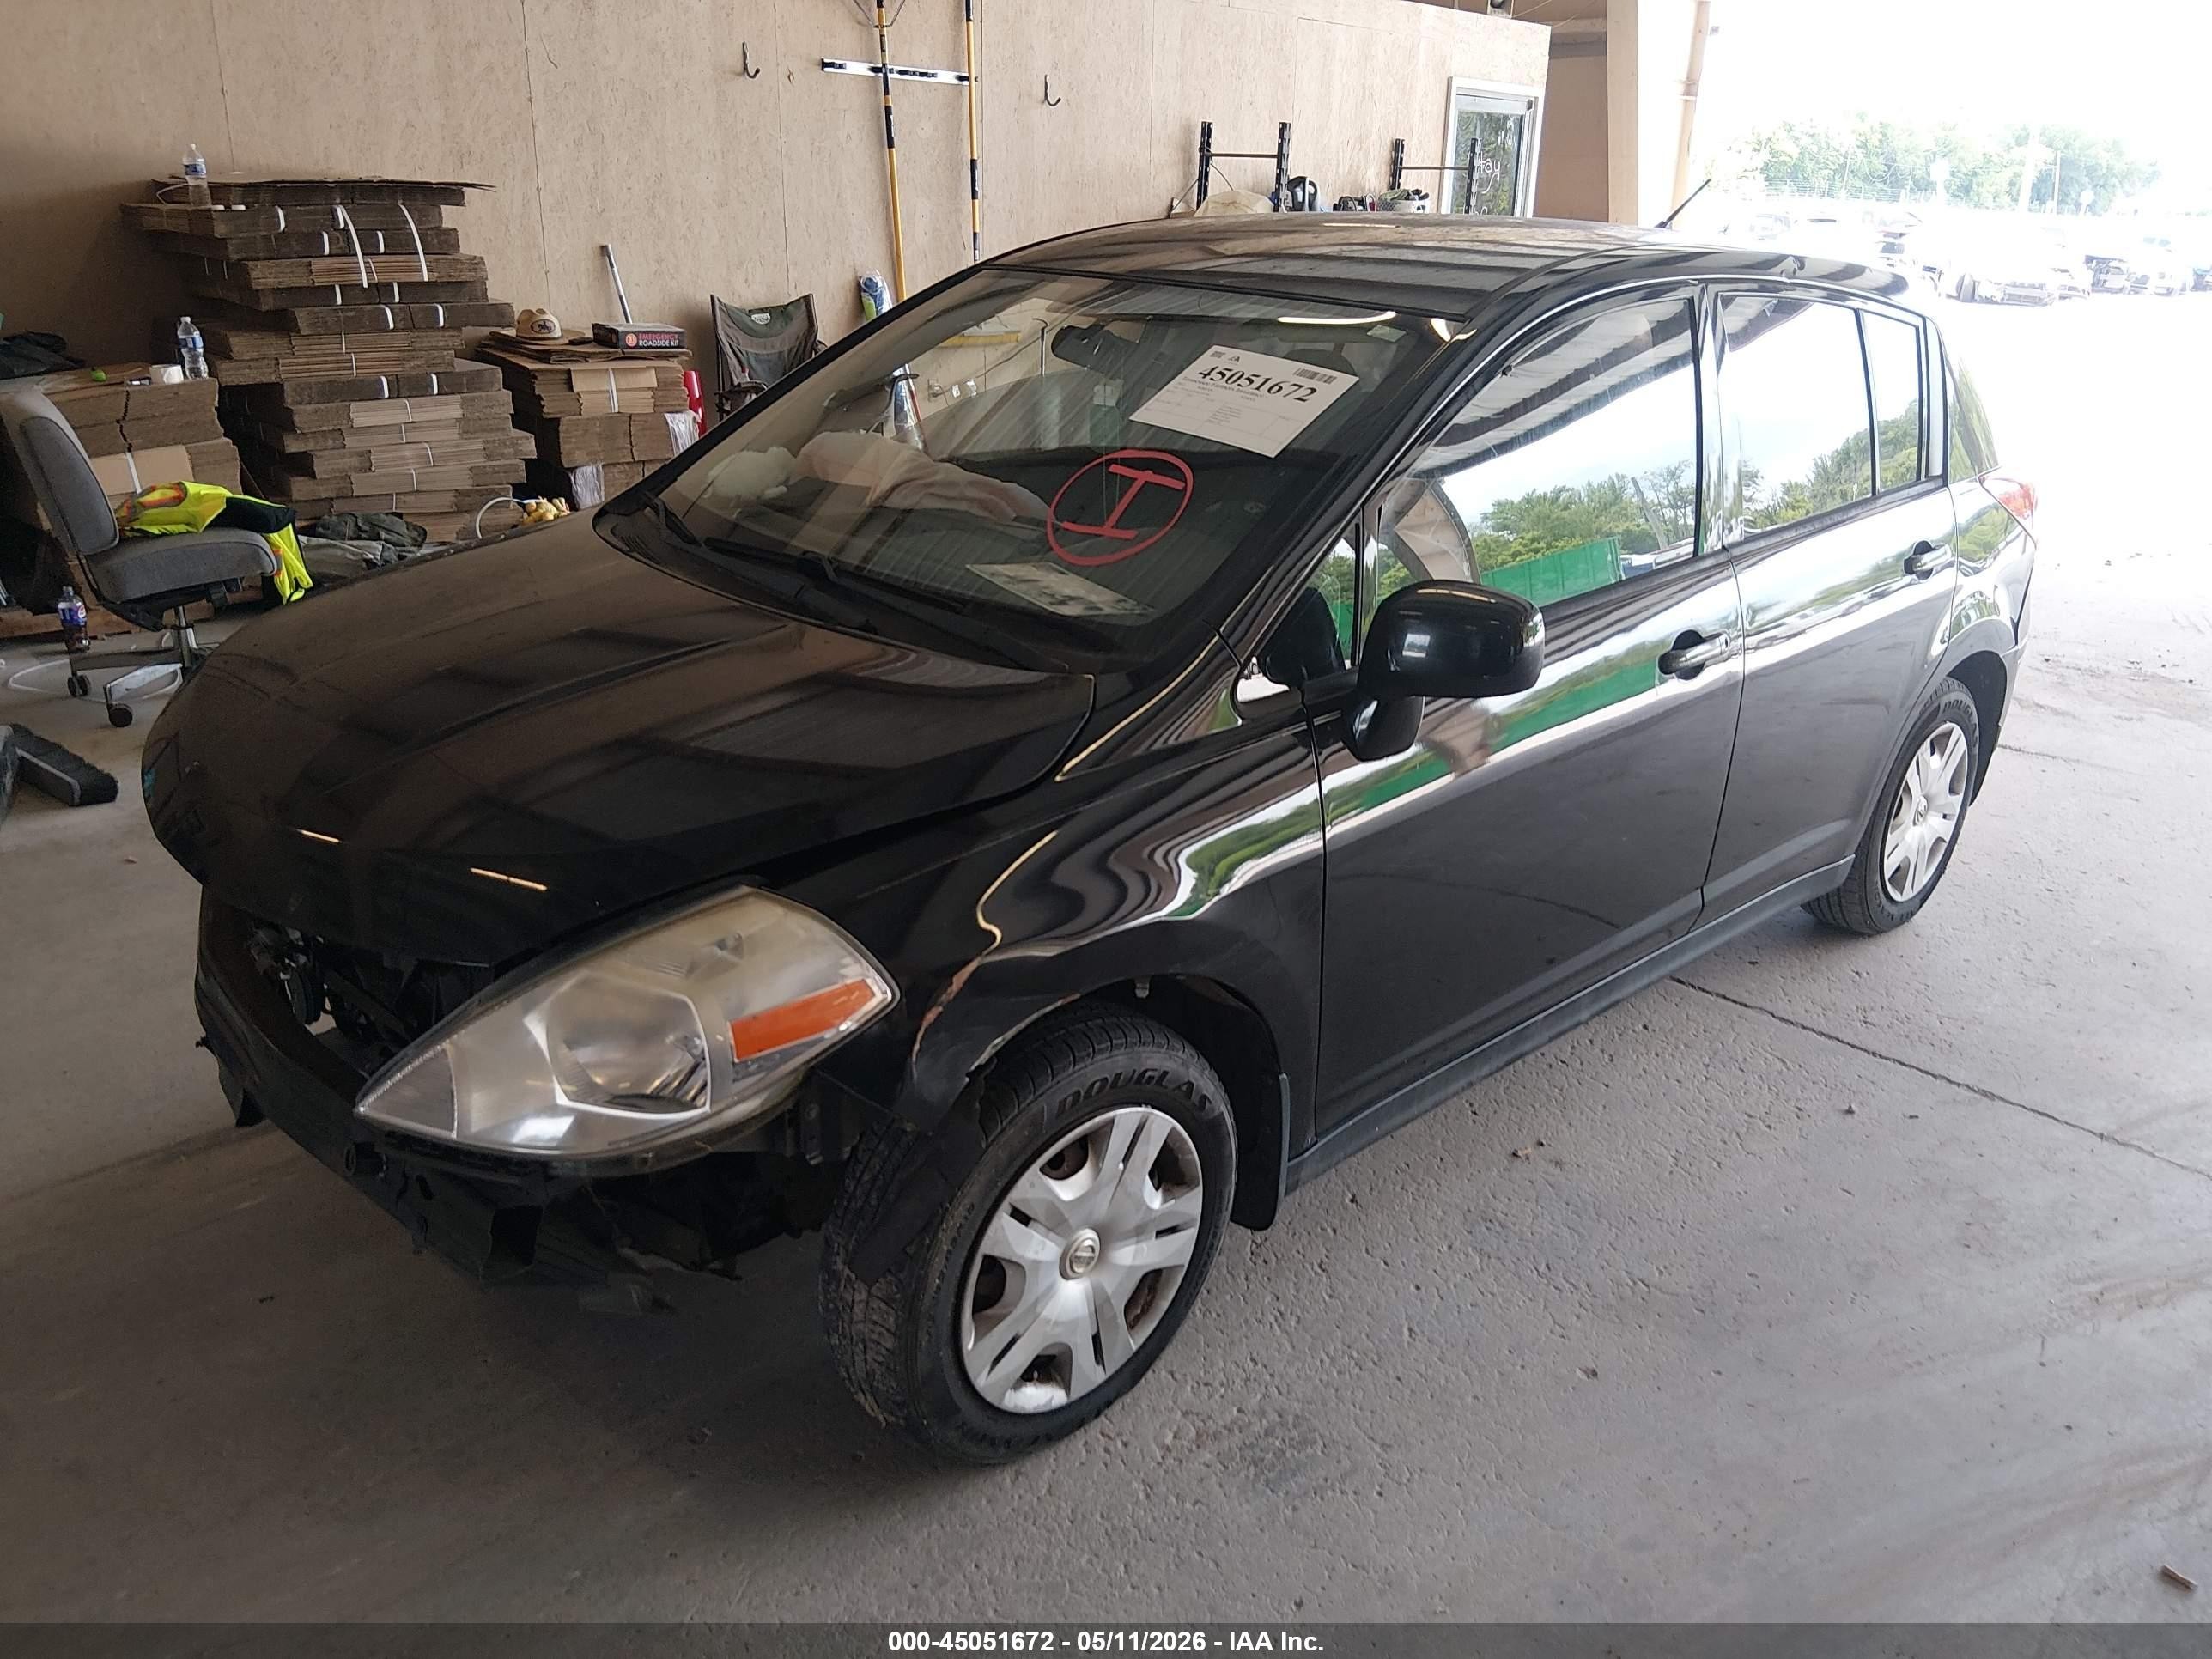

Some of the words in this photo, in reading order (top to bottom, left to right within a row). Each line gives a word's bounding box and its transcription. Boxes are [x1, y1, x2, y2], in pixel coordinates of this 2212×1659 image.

[1468, 150, 1501, 194] tay
[1198, 365, 1317, 403] 45051672
[1056, 1068, 1212, 1119] DOUGLAS
